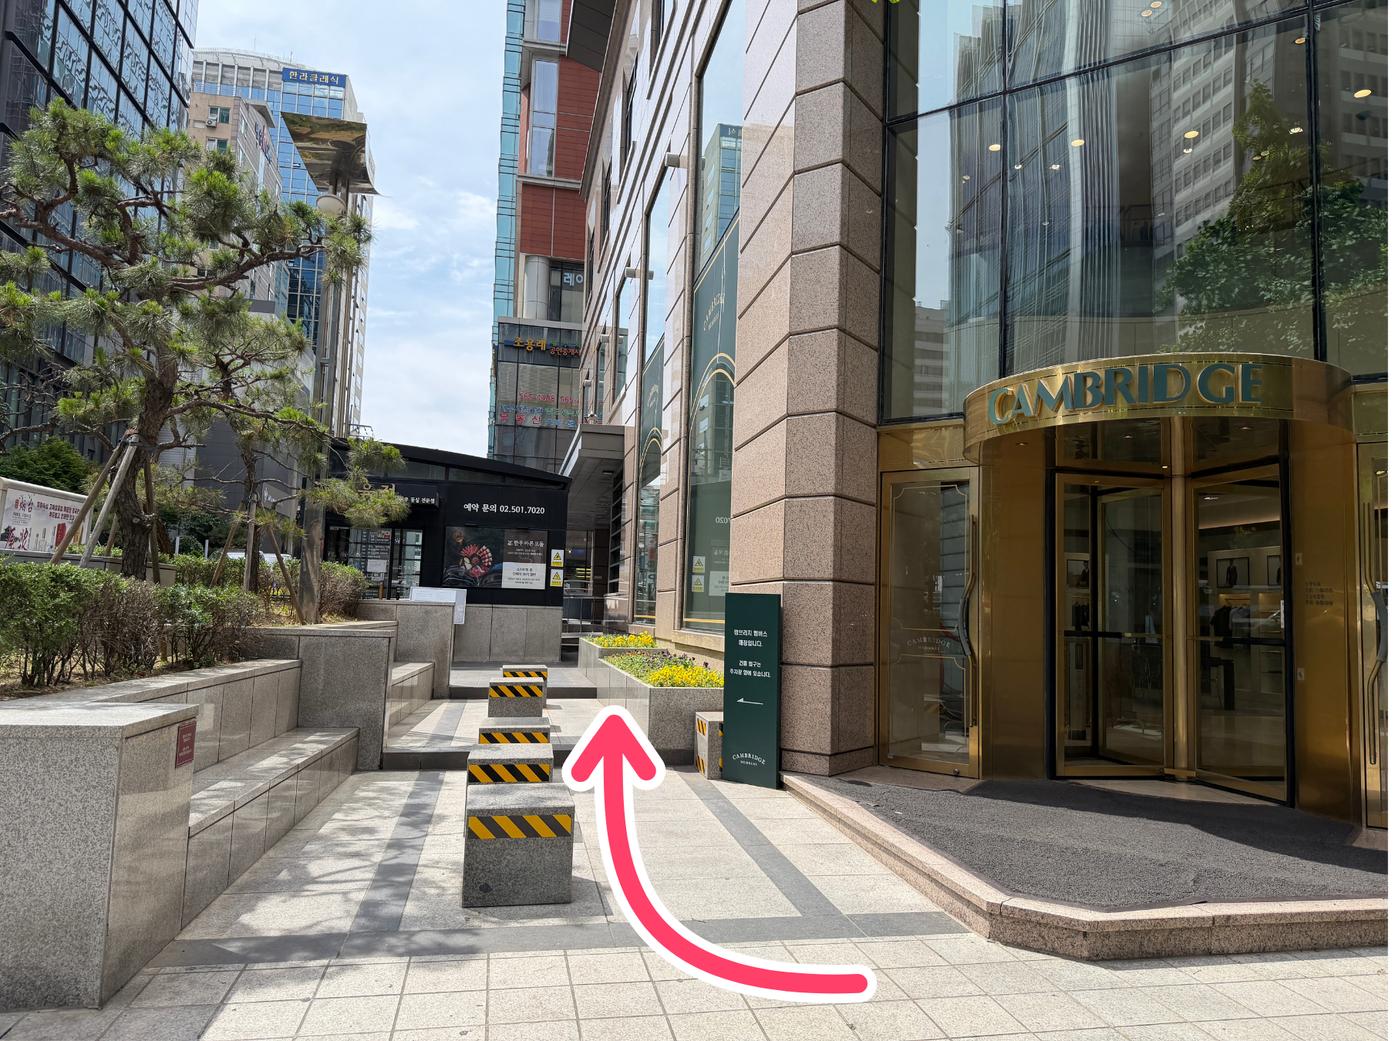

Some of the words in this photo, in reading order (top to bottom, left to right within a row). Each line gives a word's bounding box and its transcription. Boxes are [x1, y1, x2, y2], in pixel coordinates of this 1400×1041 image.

[987, 361, 1265, 427] CAMBRIDGE
[463, 503, 479, 513] 예약
[482, 503, 497, 513] 문의
[499, 504, 546, 515] 02.501.7020
[732, 752, 766, 766] CAMBRIDGE
